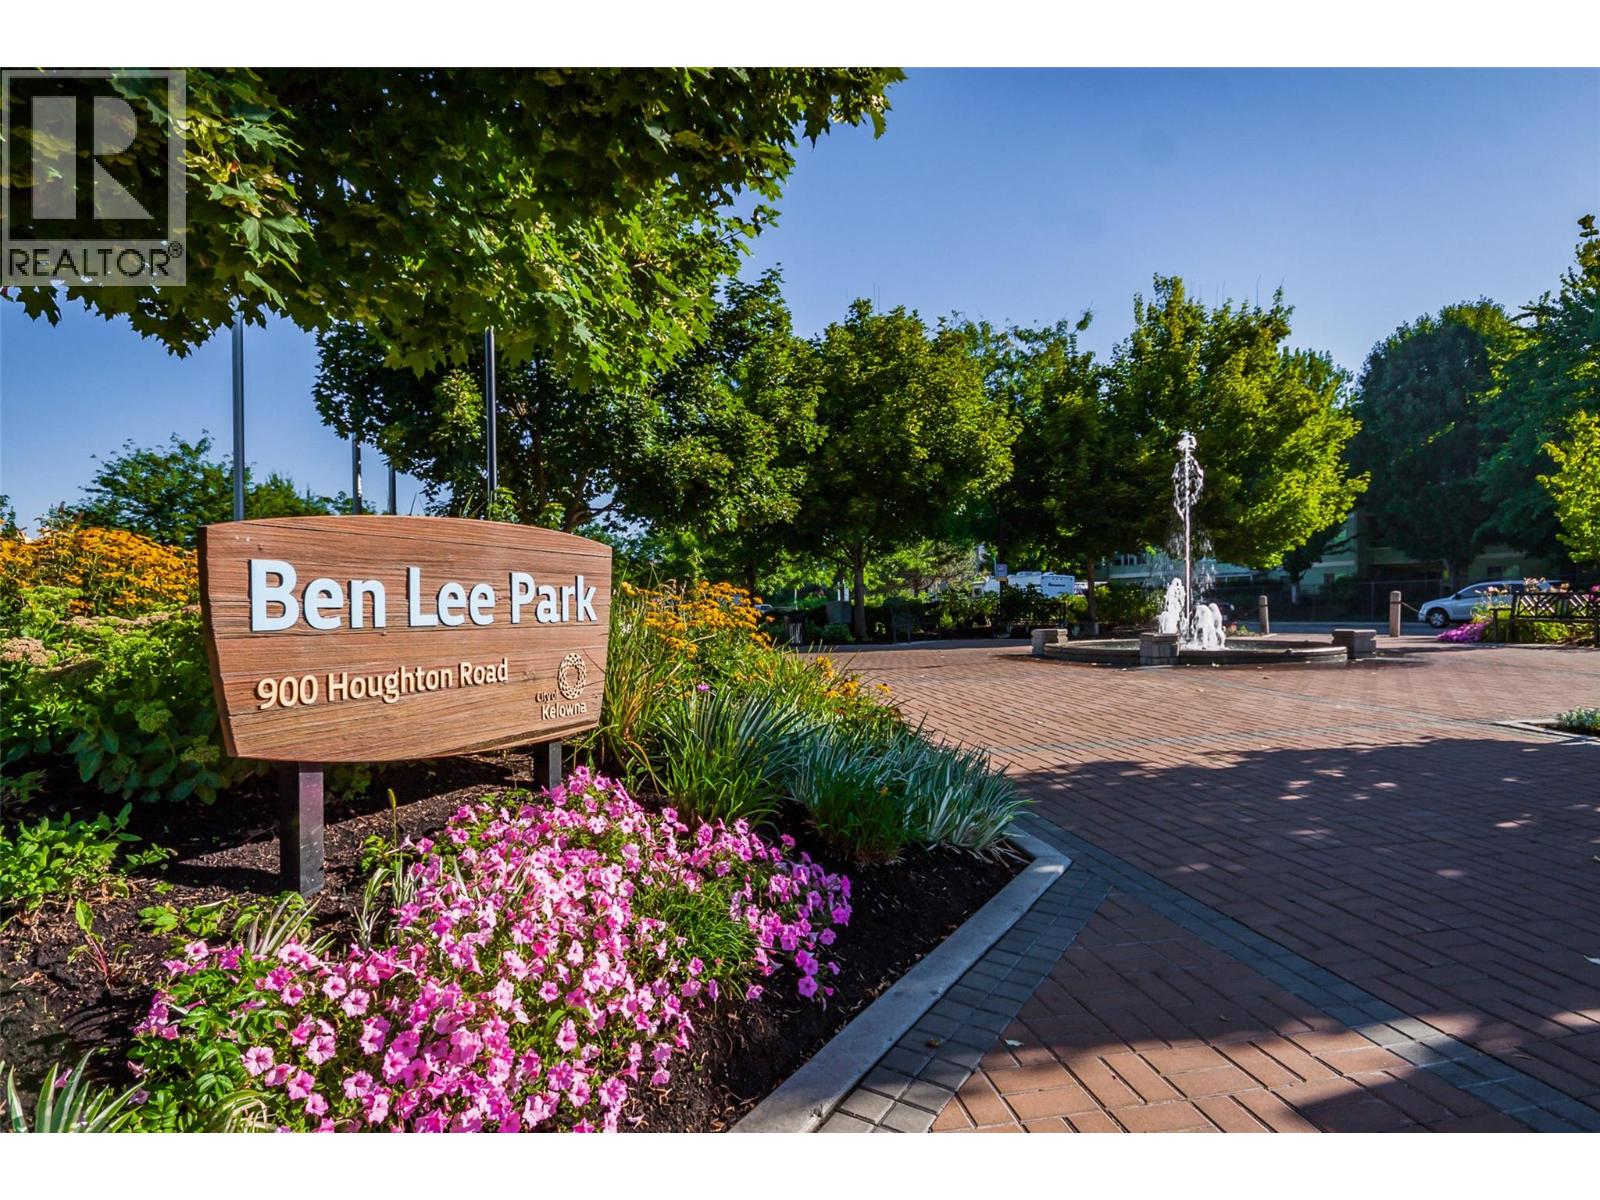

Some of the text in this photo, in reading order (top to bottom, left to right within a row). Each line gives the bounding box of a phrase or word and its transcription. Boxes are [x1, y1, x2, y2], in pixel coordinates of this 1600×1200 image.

[250, 559, 598, 632] Ben Lee Park
[256, 658, 509, 710] 900 Houghton Road
[541, 702, 587, 720] Kelowna
